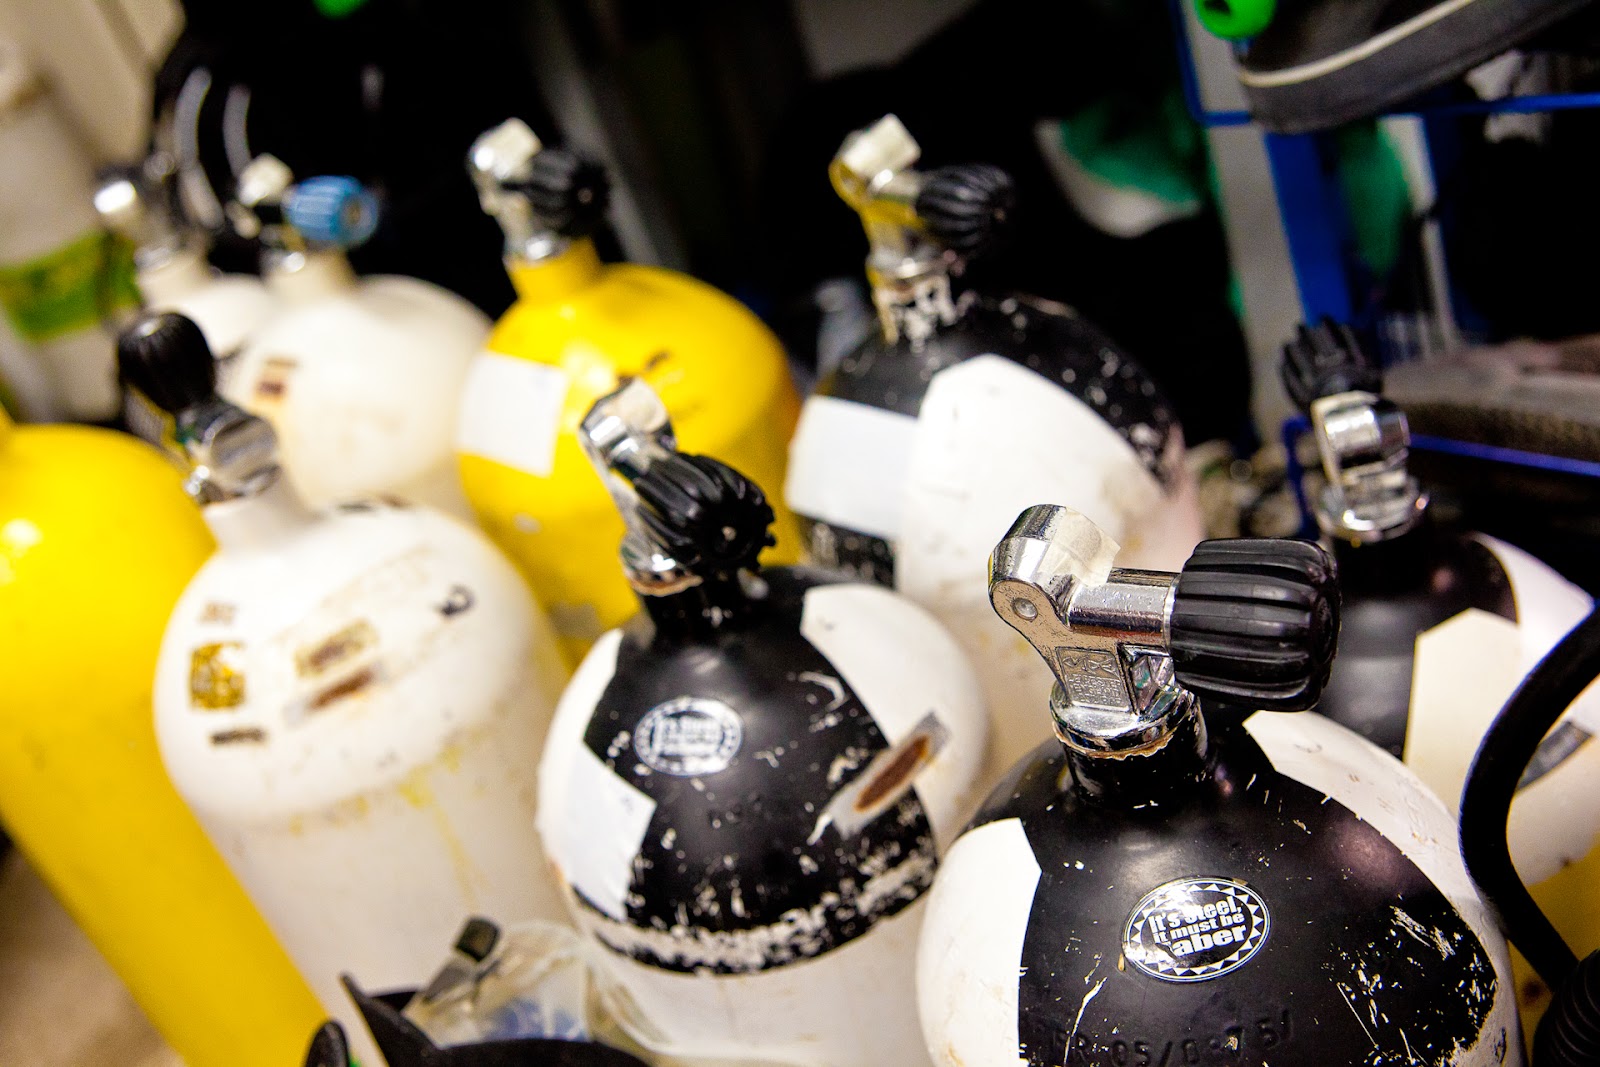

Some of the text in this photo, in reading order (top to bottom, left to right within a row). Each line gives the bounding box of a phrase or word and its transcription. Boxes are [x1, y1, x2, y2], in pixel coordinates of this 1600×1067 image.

[1148, 911, 1181, 934] It's
[1152, 911, 1246, 944] it must be
[1165, 923, 1247, 957] aber
